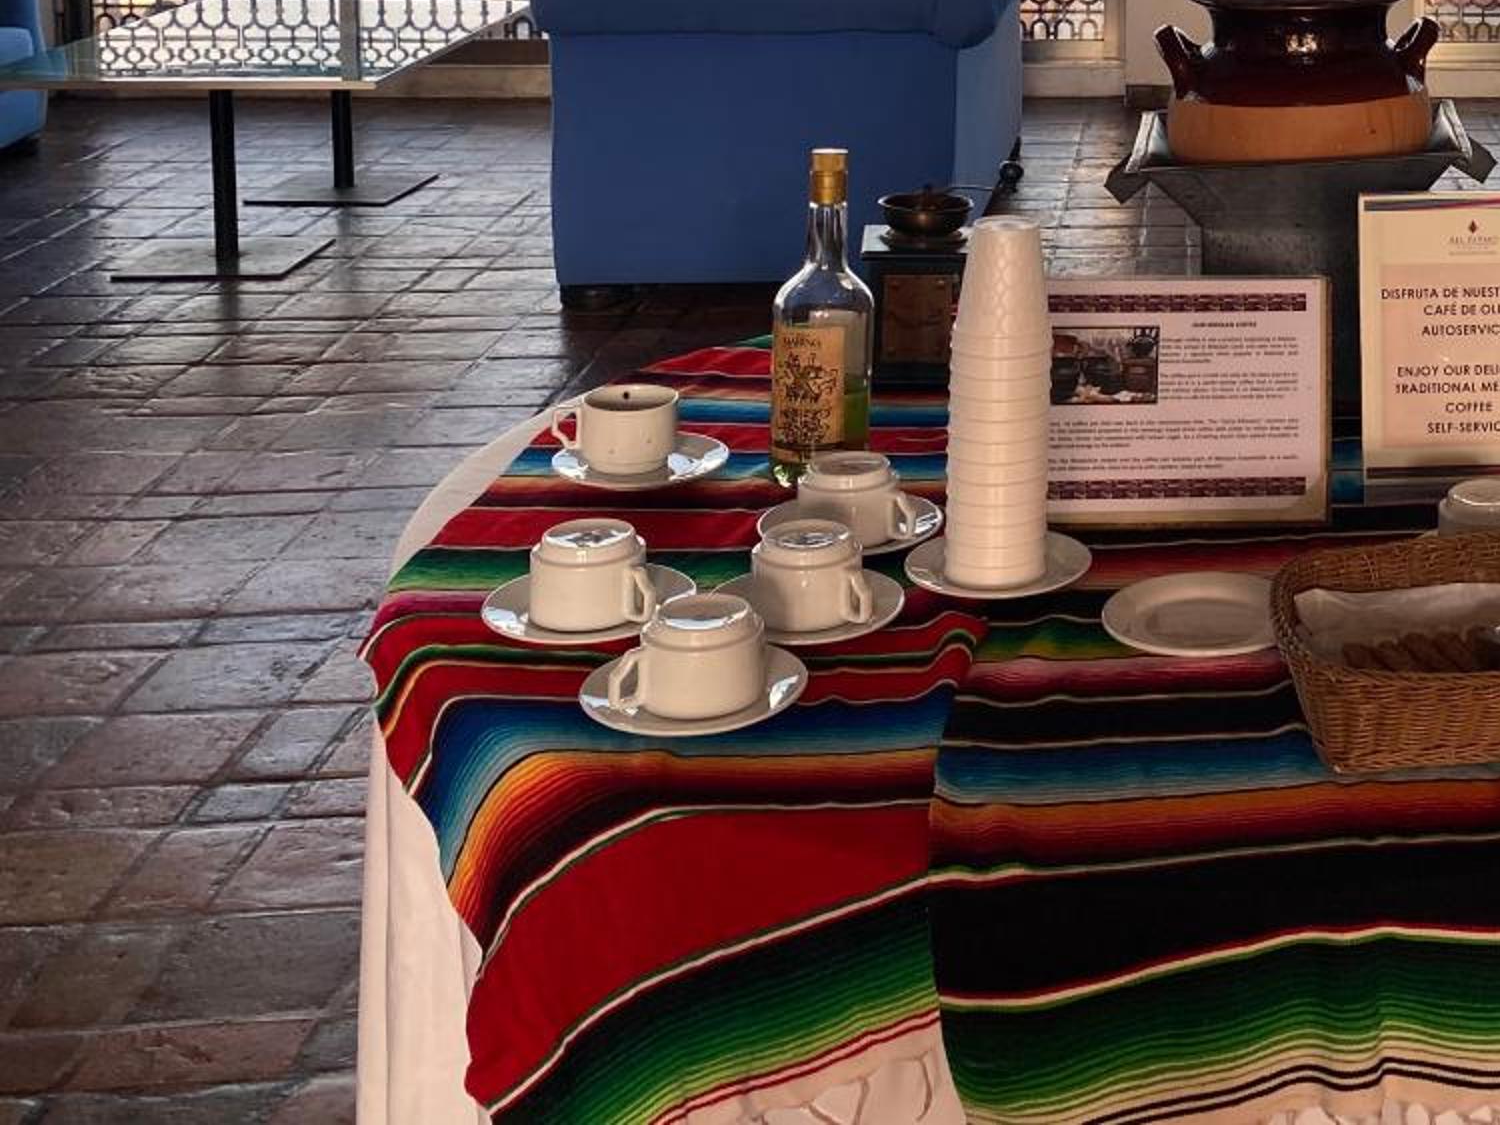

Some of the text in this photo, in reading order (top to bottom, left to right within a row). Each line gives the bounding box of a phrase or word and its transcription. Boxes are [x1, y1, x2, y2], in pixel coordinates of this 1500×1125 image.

[1381, 288, 1439, 300] DISFRUTA
[1443, 287, 1458, 298] DE
[1423, 302, 1457, 316] CAFÉ
[1461, 304, 1476, 315] DE
[1397, 366, 1439, 377] ENJOY
[1443, 364, 1471, 376] OUR
[1395, 382, 1477, 394] TRADITIONAL
[1445, 401, 1494, 414] COFFEE
